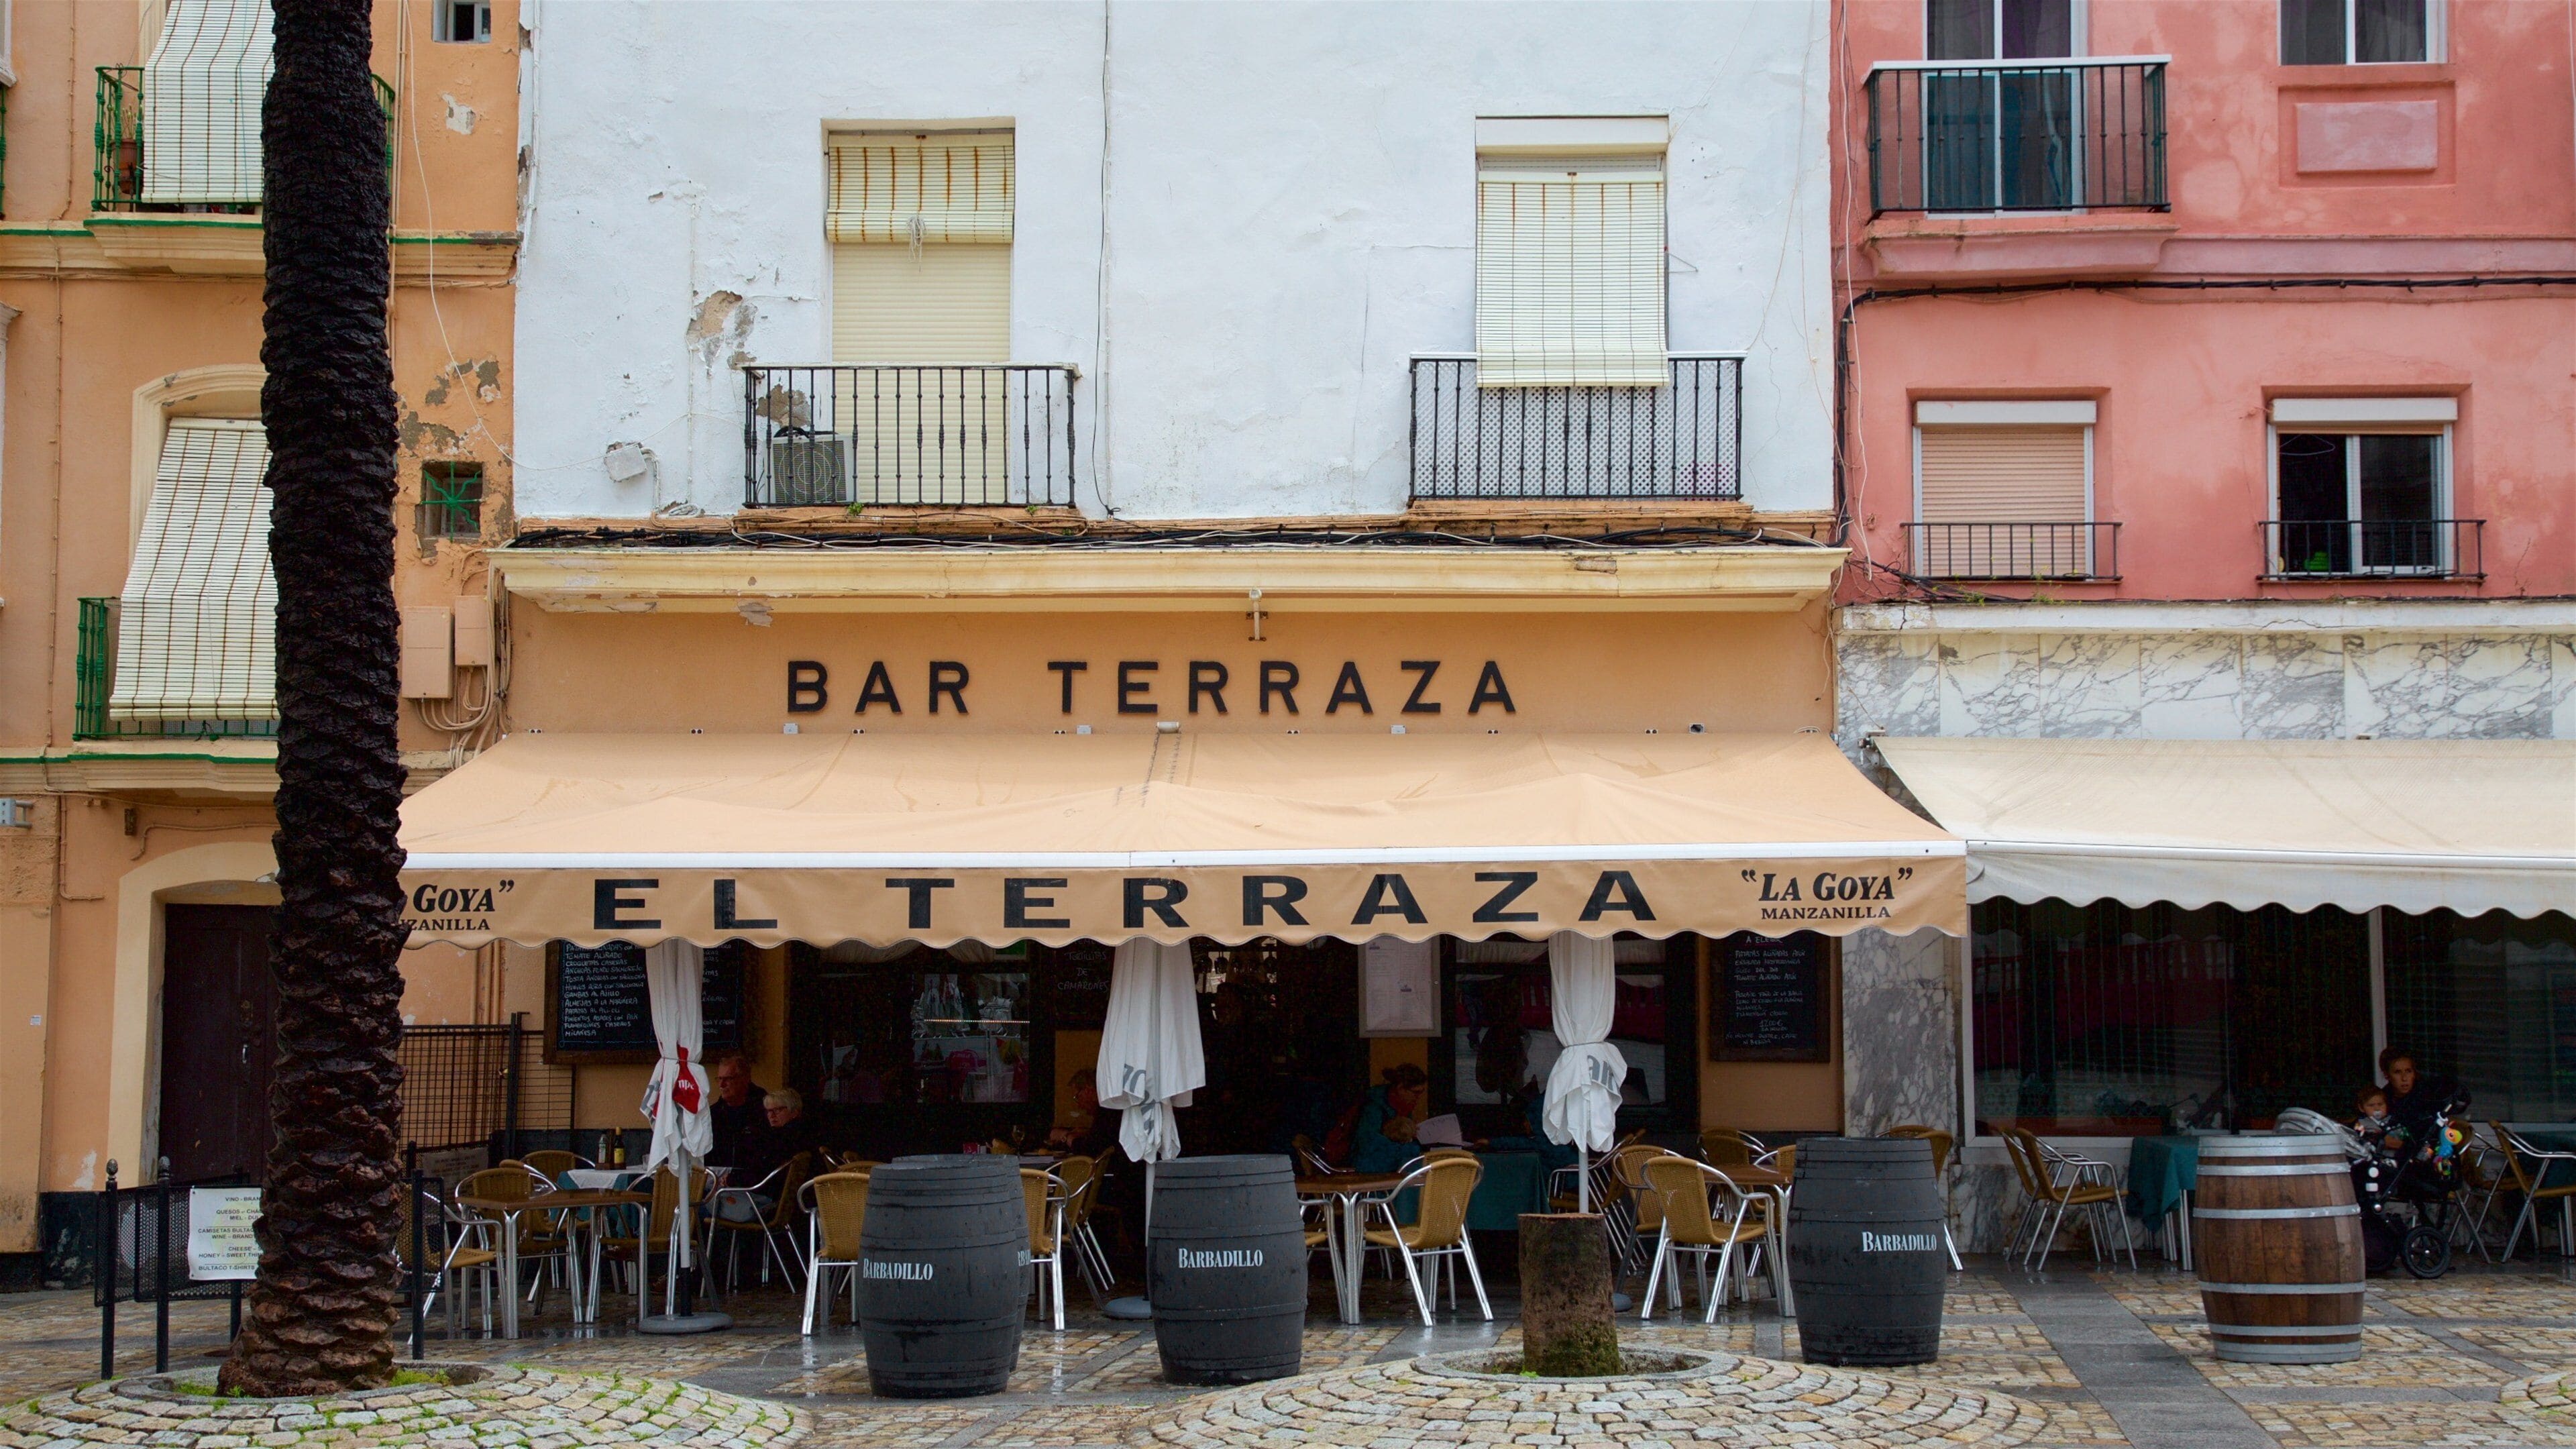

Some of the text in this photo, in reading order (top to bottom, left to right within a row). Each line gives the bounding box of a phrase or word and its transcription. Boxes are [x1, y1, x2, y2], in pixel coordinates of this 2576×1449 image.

[787, 660, 1516, 714] BAR TERRAZA
[593, 870, 1657, 930] EL TERRAZA
[1761, 906, 1892, 920] MANZANILLA
[1862, 1231, 1937, 1252] BARBADILLO
[863, 1258, 934, 1281] BARBADILLO
[1178, 1248, 1264, 1269] BARBADILLO
